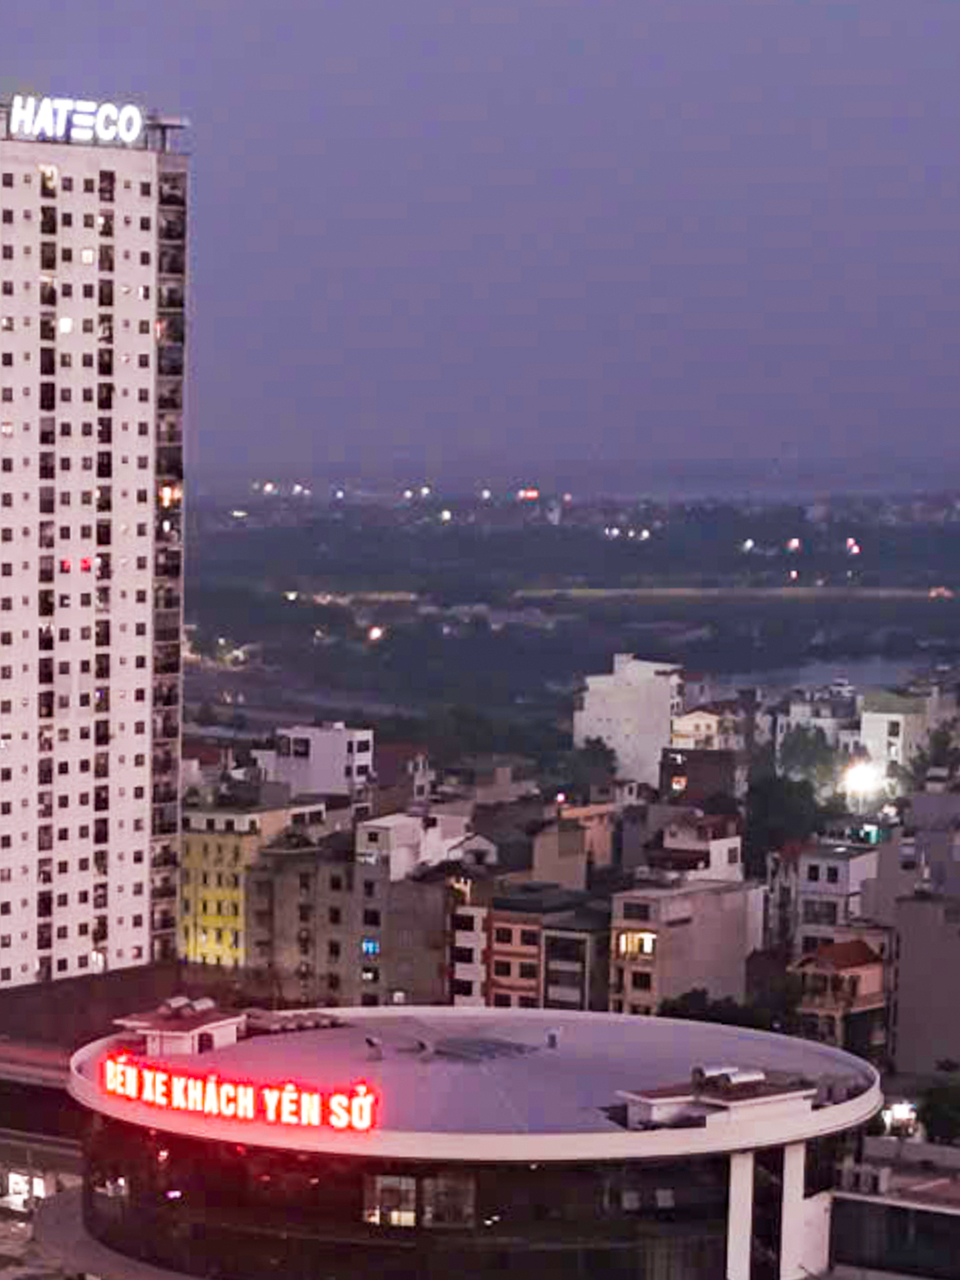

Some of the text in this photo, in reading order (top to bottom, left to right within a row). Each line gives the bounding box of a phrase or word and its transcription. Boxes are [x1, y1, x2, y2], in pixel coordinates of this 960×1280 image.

[10, 95, 143, 142] HATECO
[141, 1068, 168, 1106] XE
[171, 1074, 254, 1119] KHÁCH
[262, 1082, 321, 1126] YÊN
[329, 1083, 375, 1130] SỞ
